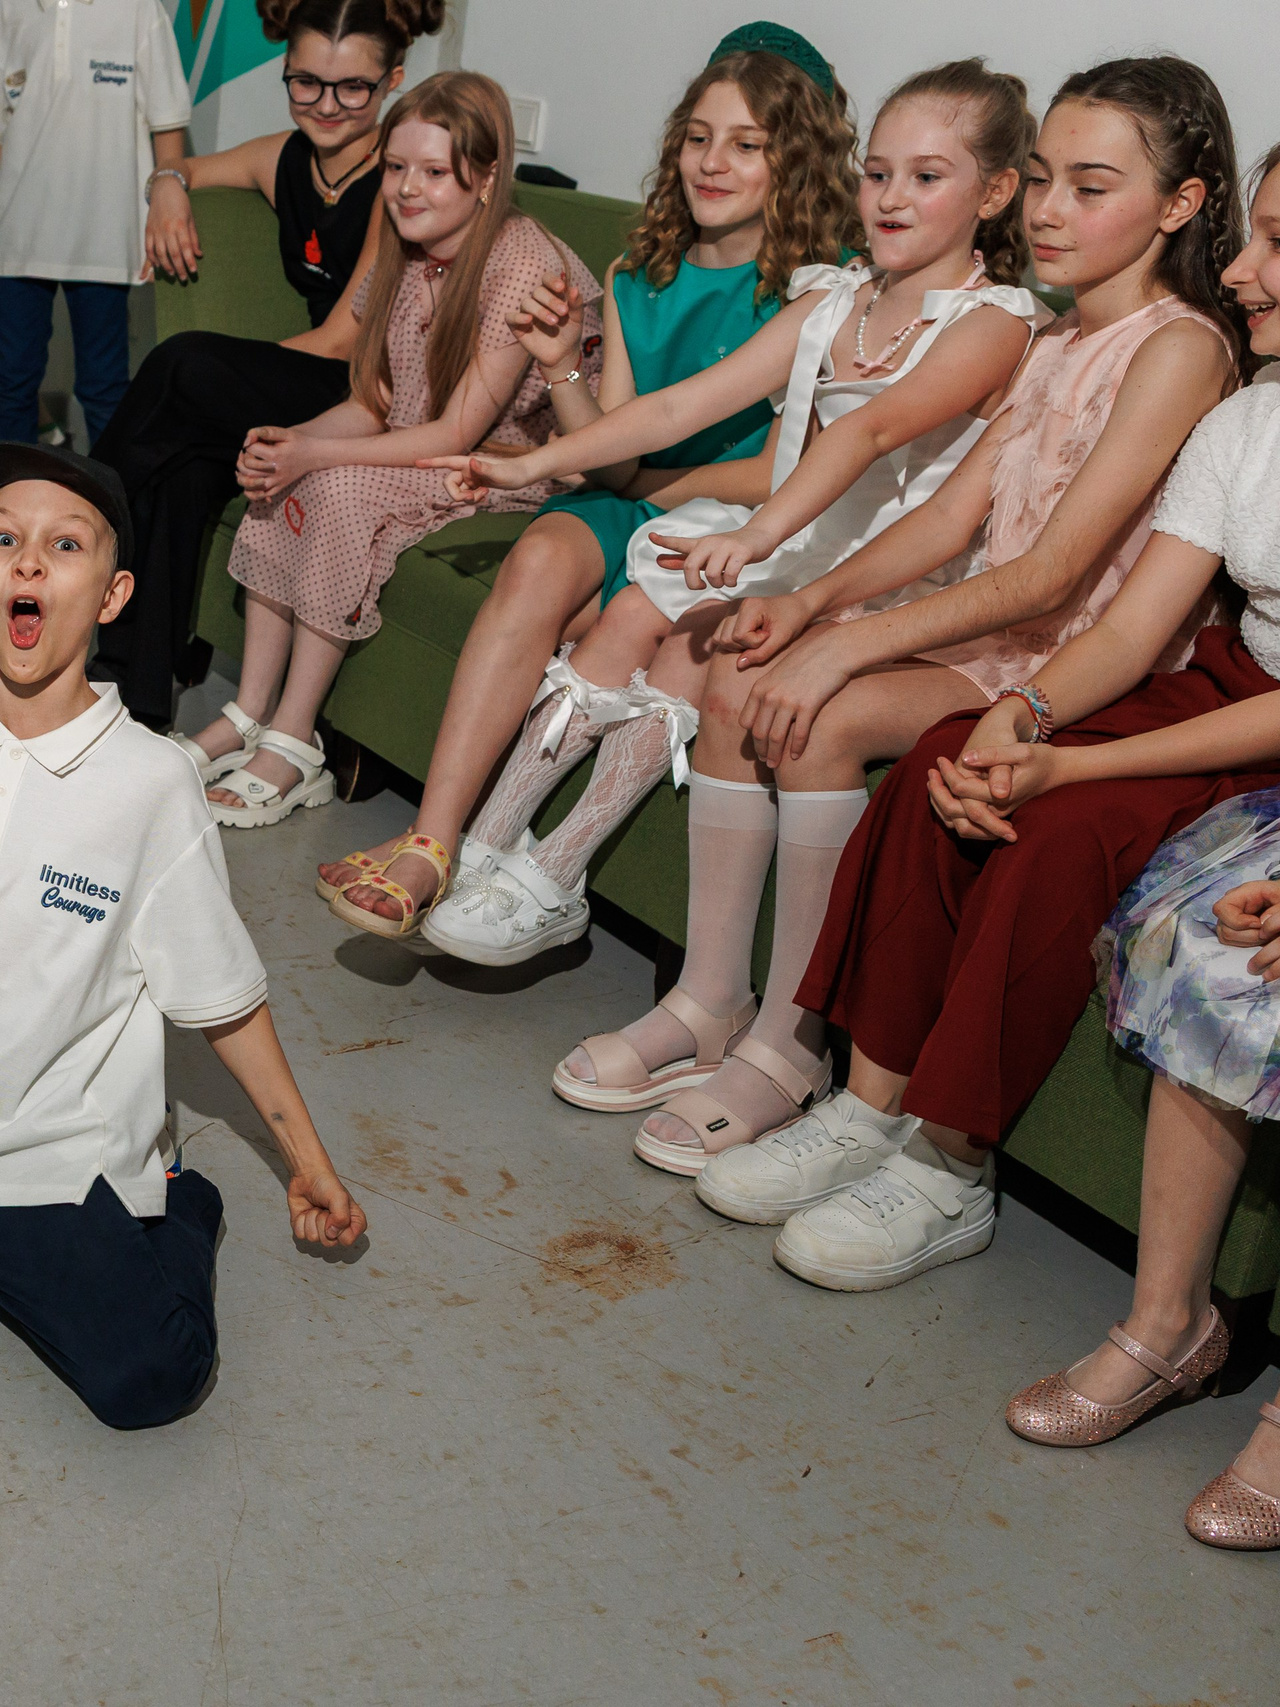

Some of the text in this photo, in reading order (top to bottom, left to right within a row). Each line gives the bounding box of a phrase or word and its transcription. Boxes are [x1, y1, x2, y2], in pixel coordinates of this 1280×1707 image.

[89, 59, 134, 72] limitless
[39, 863, 121, 903] limitless
[40, 886, 107, 924] Courage
